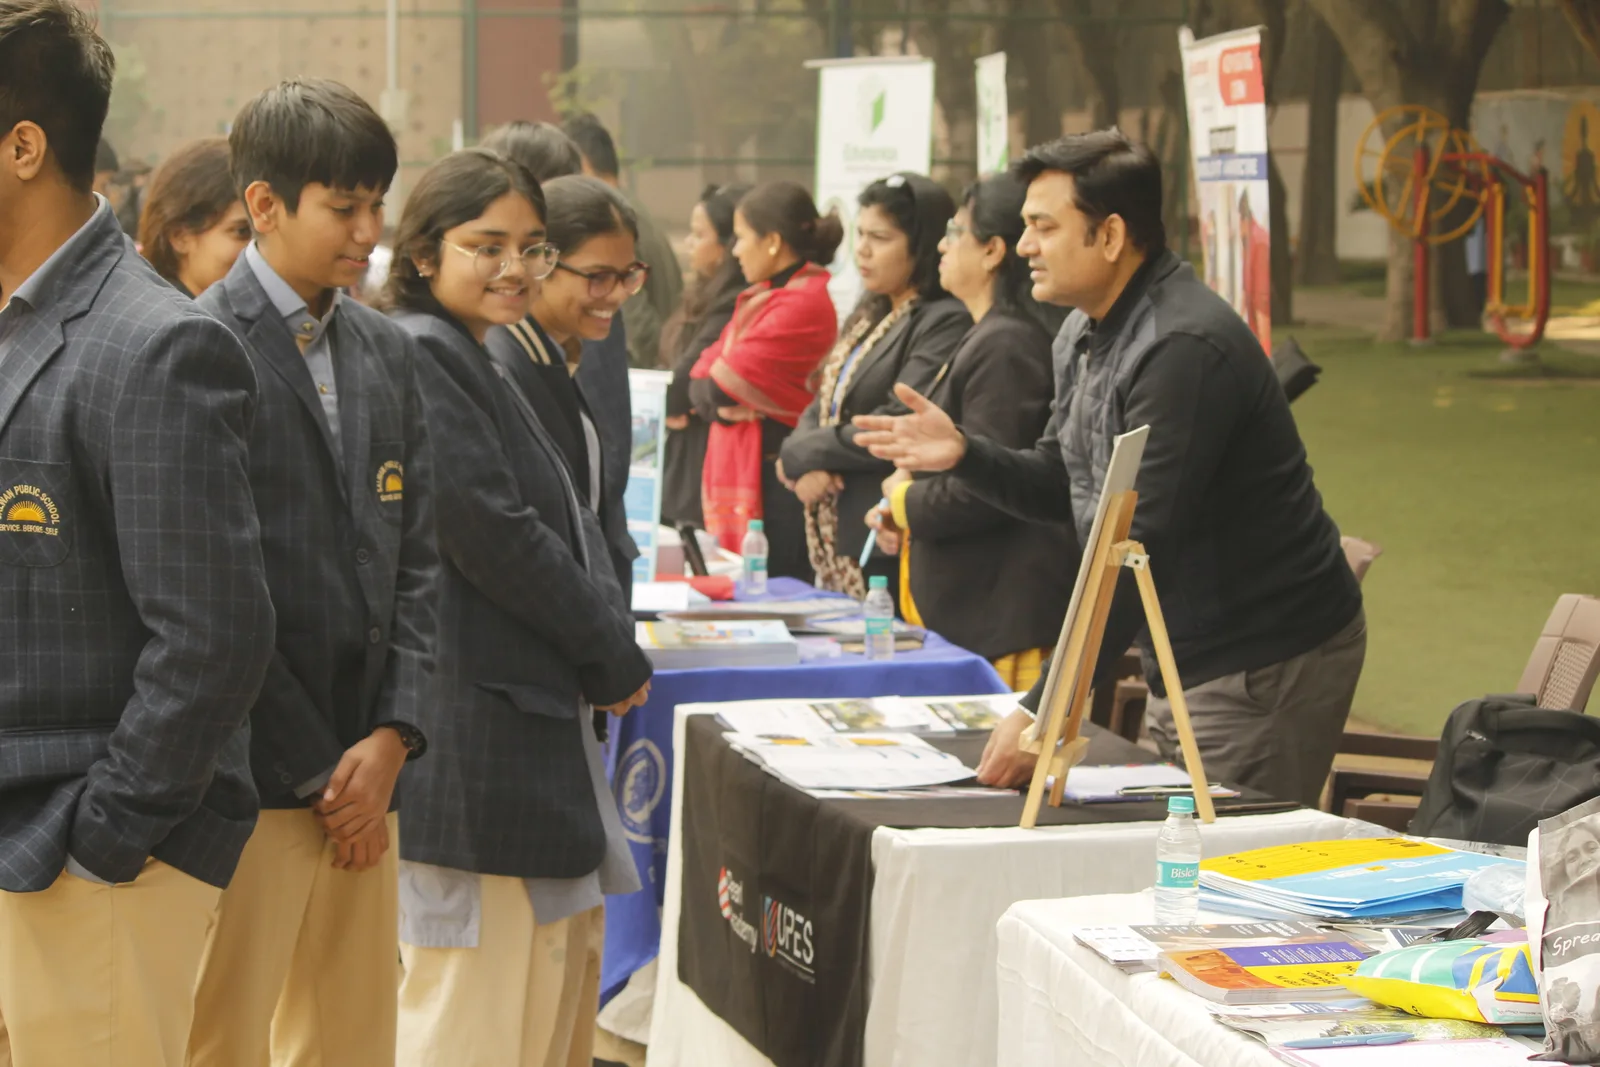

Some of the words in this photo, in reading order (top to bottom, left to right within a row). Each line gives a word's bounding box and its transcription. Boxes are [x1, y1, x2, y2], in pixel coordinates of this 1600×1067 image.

[13, 484, 40, 497] PUBLIC
[40, 492, 60, 525] SCHOOL
[0, 523, 20, 532] ERVICE
[22, 524, 44, 533] BEFORE
[45, 526, 58, 536] SELF
[776, 902, 814, 965] UPES
[1551, 932, 1600, 956] Sprea
